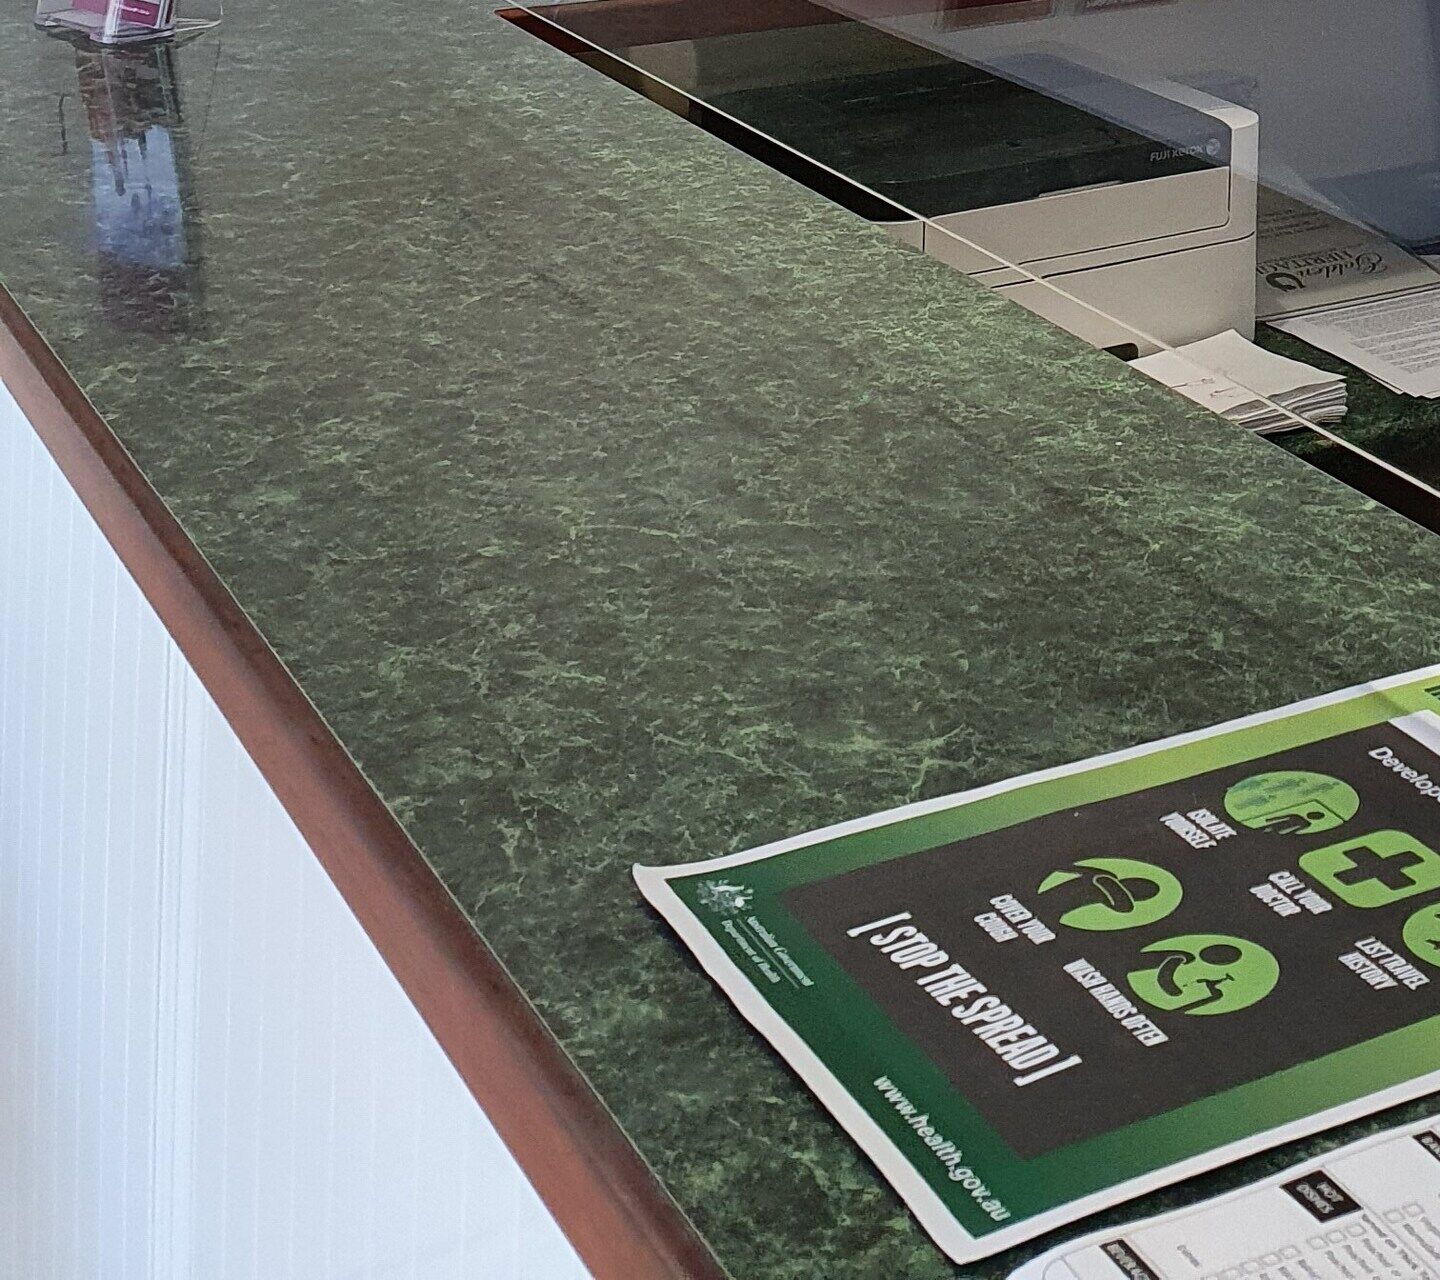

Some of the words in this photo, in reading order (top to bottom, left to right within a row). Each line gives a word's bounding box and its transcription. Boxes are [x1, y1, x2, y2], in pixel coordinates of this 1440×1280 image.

[1149, 150, 1170, 162] FUJI
[1159, 811, 1218, 850] YOURSELF
[1267, 870, 1306, 895] CALL
[869, 925, 950, 970] STOP
[1354, 936, 1394, 958] LIST
[1378, 953, 1431, 990] TRAVEL
[916, 963, 988, 1007] THE
[1338, 951, 1398, 990] HISTORY
[1063, 957, 1108, 989] WASH
[1088, 983, 1138, 1020] HANDS
[1121, 1014, 1169, 1047] OFTEN
[951, 994, 1060, 1071] SPREAD
[872, 1074, 1011, 1222] www.health.gov.au
